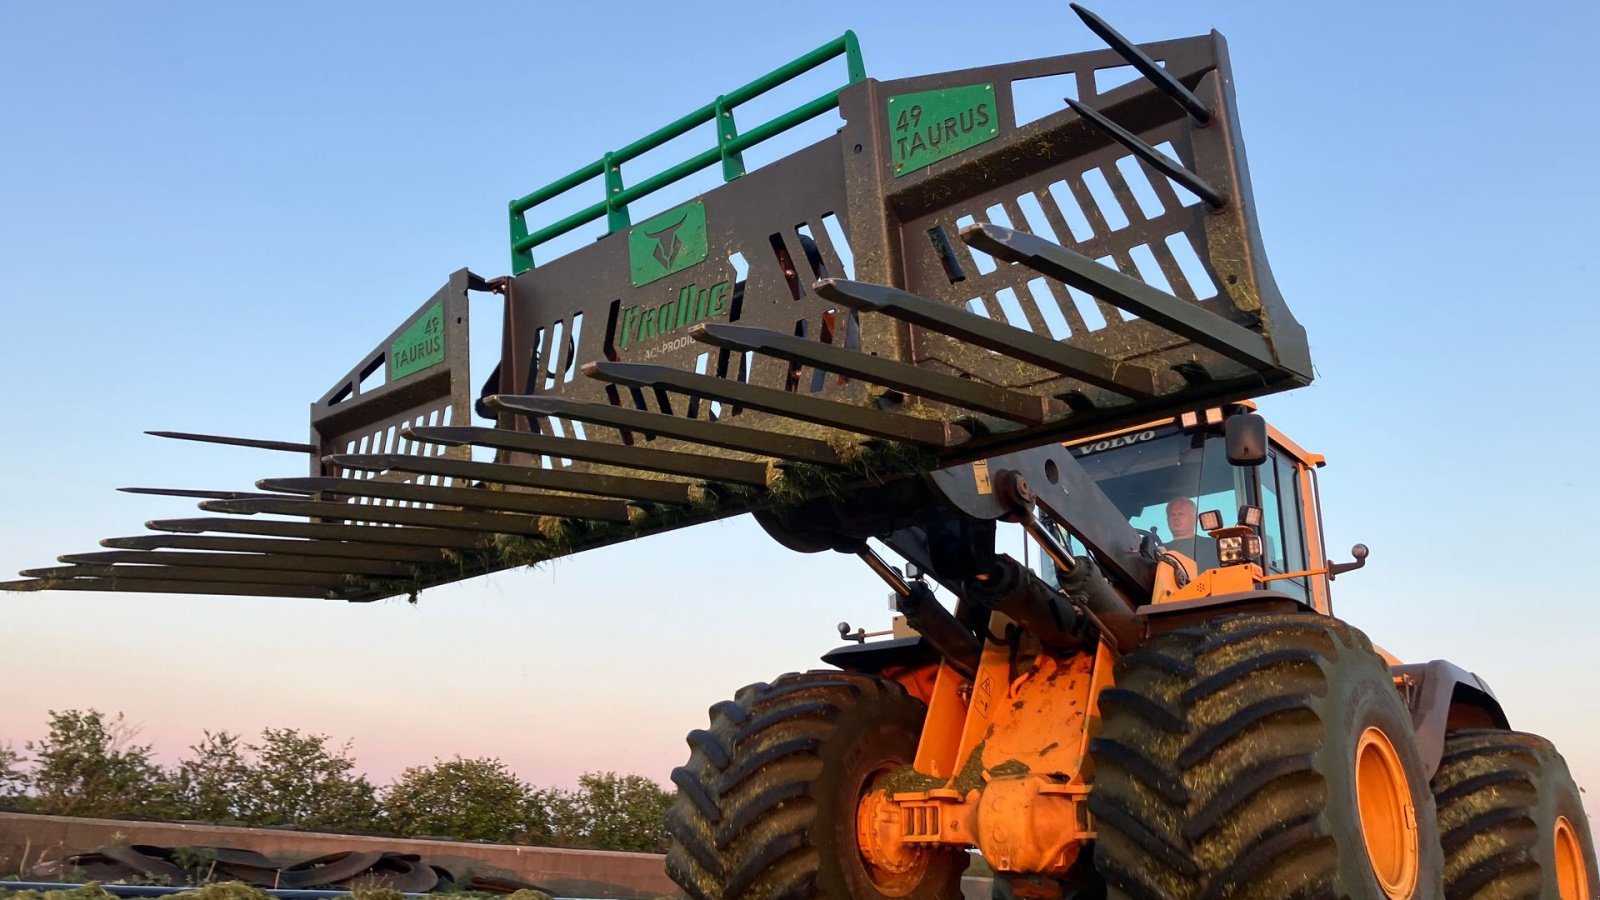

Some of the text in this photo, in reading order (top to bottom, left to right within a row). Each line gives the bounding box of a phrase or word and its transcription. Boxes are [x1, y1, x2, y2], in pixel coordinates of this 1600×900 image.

[896, 105, 922, 132] 49
[897, 103, 990, 160] TAURUS
[424, 317, 439, 336] 49
[394, 336, 441, 369] TAURUS
[1079, 430, 1156, 455] VOLVO
